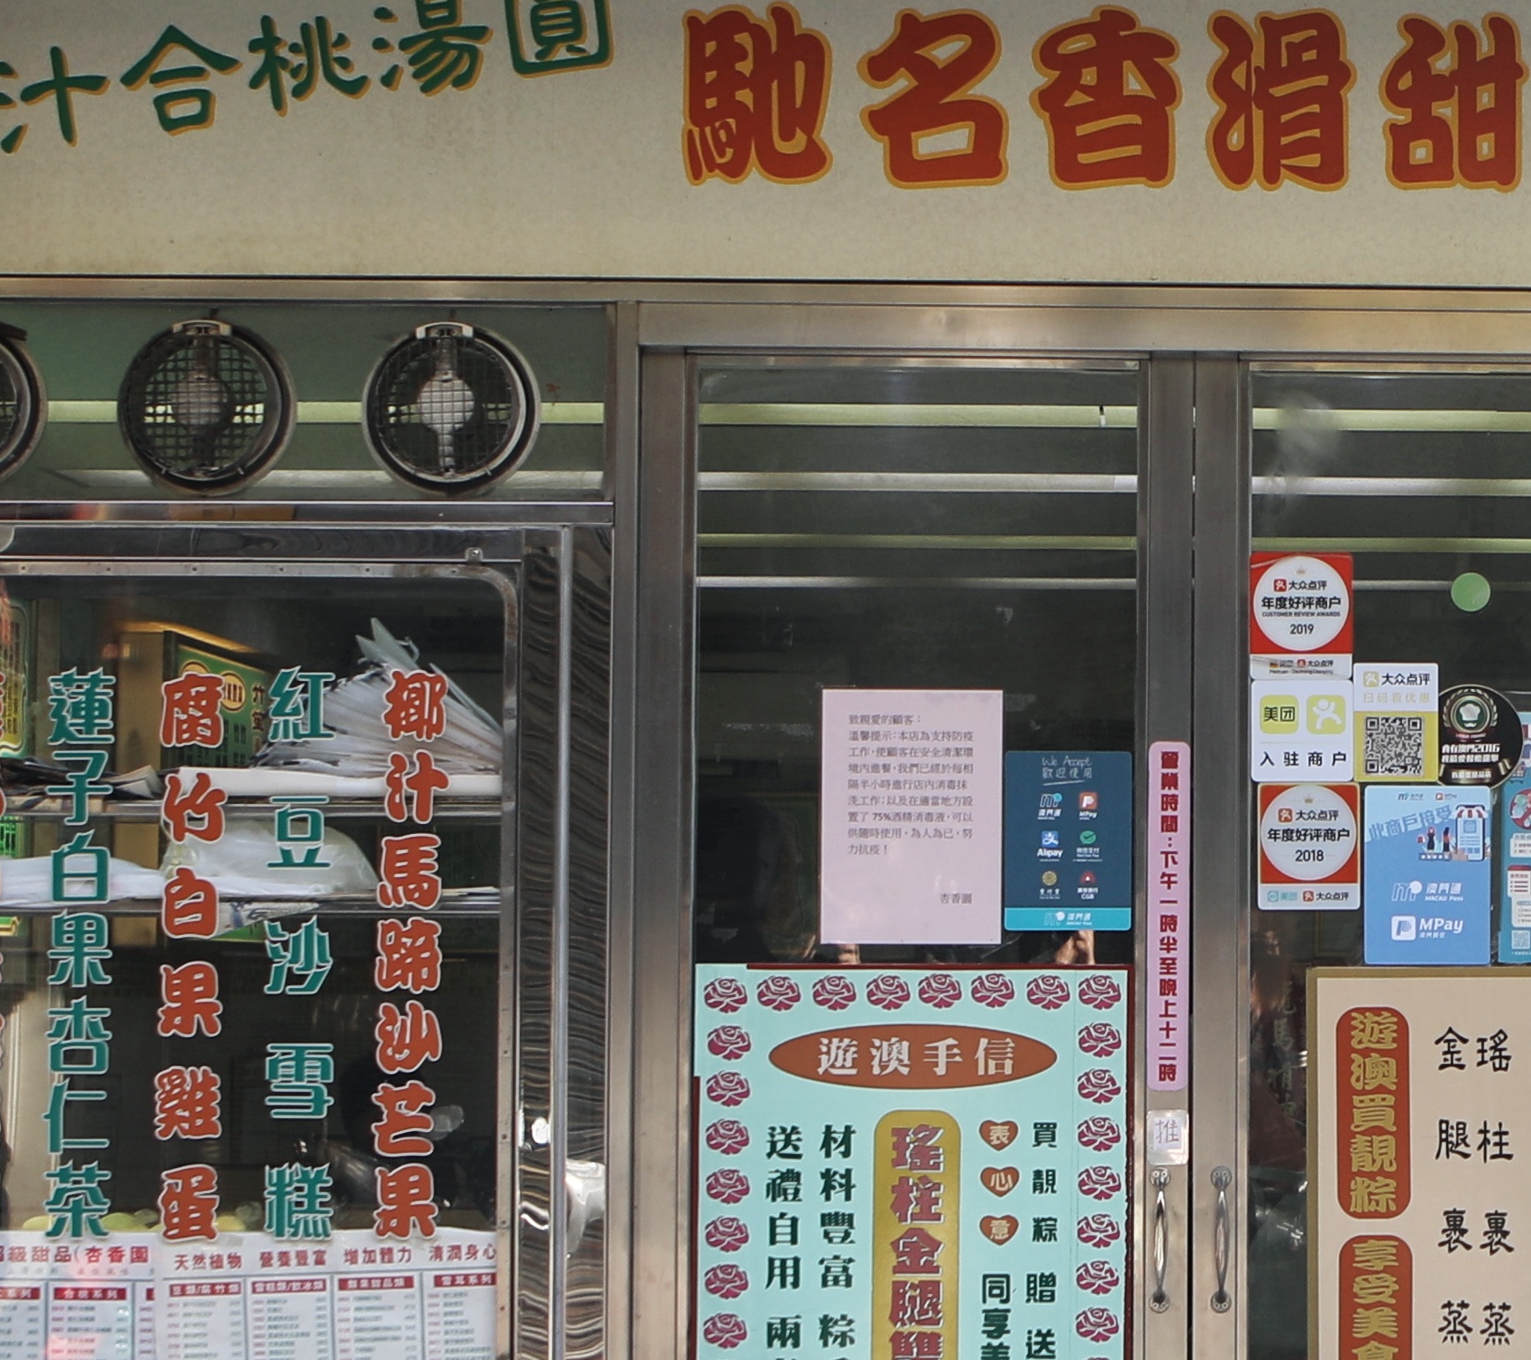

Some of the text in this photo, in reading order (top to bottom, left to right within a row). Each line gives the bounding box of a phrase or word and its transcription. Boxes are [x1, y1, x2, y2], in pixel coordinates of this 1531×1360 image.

[1289, 580, 1327, 591] 大众点评
[1261, 596, 1341, 610] 年度好评商户
[1290, 623, 1315, 635] 2019
[1381, 673, 1431, 686] 大众点评
[1363, 692, 1430, 704] 扫码看优惠
[1263, 706, 1296, 722] 美团
[1041, 755, 1093, 768] We Accept
[1260, 751, 1347, 767] 入驻商户
[1295, 810, 1339, 821] 大众点评
[1267, 828, 1350, 842] 年度好评商户
[1295, 849, 1324, 862] 2018
[1425, 882, 1462, 894] 澳門通
[1419, 917, 1464, 934] MPay
[43, 665, 117, 1240] 蓮子白果杏仁茶
[153, 670, 227, 1243] 腐竹白果雞蛋
[263, 664, 336, 1242] 紅豆沙雪糕
[371, 668, 450, 1241] 椰汁馬蹄沙芒果
[817, 1036, 1016, 1077] 遊澳手信
[1349, 1011, 1398, 1214] 遊澳買靚粽
[1155, 1119, 1179, 1144] 推
[988, 1125, 1013, 1241] 表心意
[1031, 1121, 1059, 1244] 買靚粽
[765, 1125, 803, 1291] 送禮自用
[819, 1124, 856, 1290] 材料豐富
[174, 1252, 243, 1272] 天然植物
[259, 1248, 328, 1268] 營養豐富
[344, 1246, 413, 1265] 增加體力
[429, 1243, 497, 1262] 清潤身心
